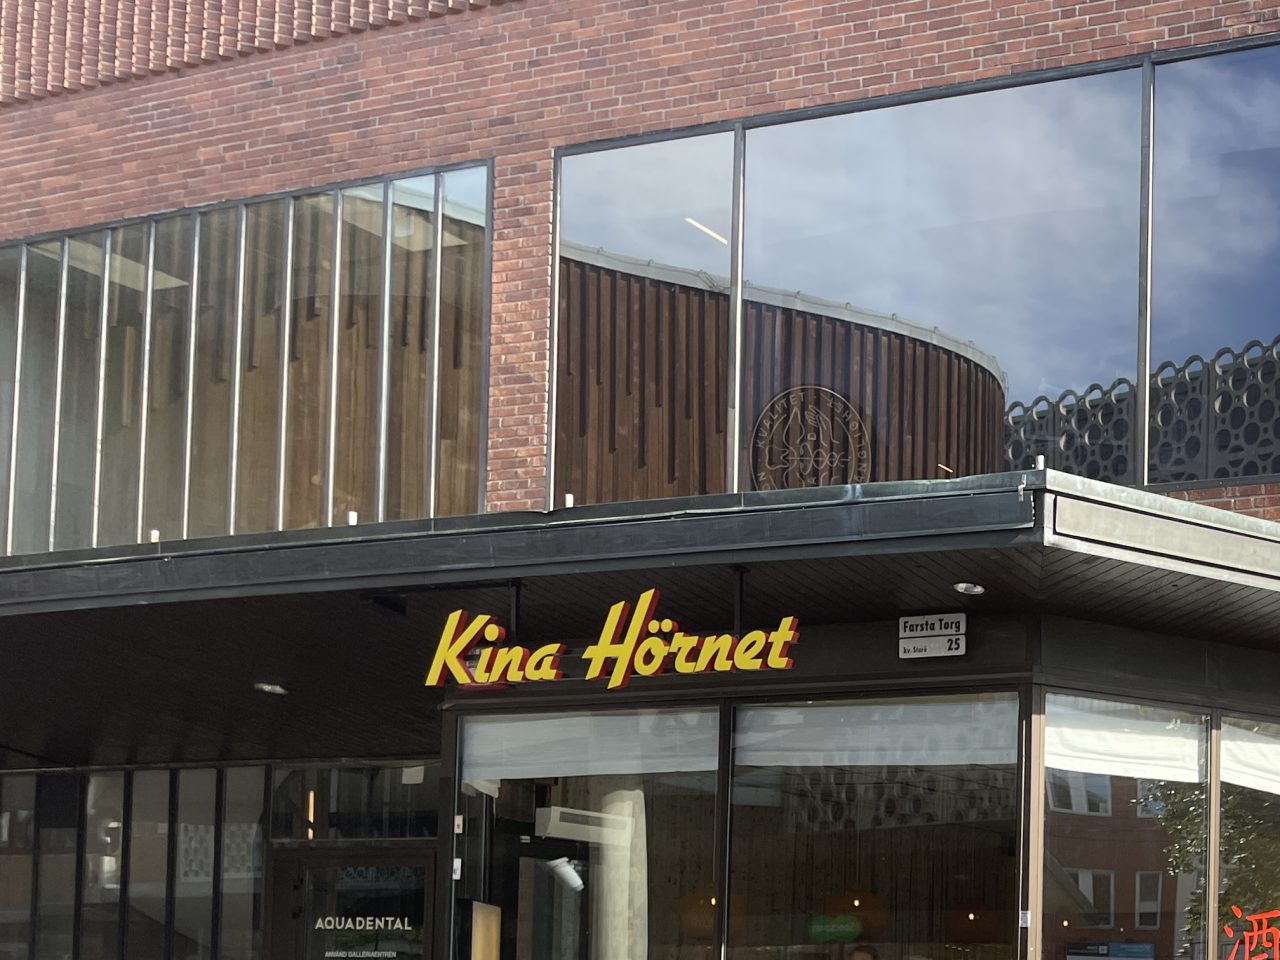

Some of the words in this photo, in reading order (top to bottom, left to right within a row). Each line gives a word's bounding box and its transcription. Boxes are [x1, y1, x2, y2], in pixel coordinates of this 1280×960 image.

[756, 392, 805, 449] KVALITET
[903, 620, 936, 633] Farsta
[938, 618, 961, 633] Torg
[424, 608, 566, 688] Kina
[581, 587, 799, 689] Hörnet
[947, 638, 961, 651] 25
[314, 916, 412, 930] AQUADENTAL
